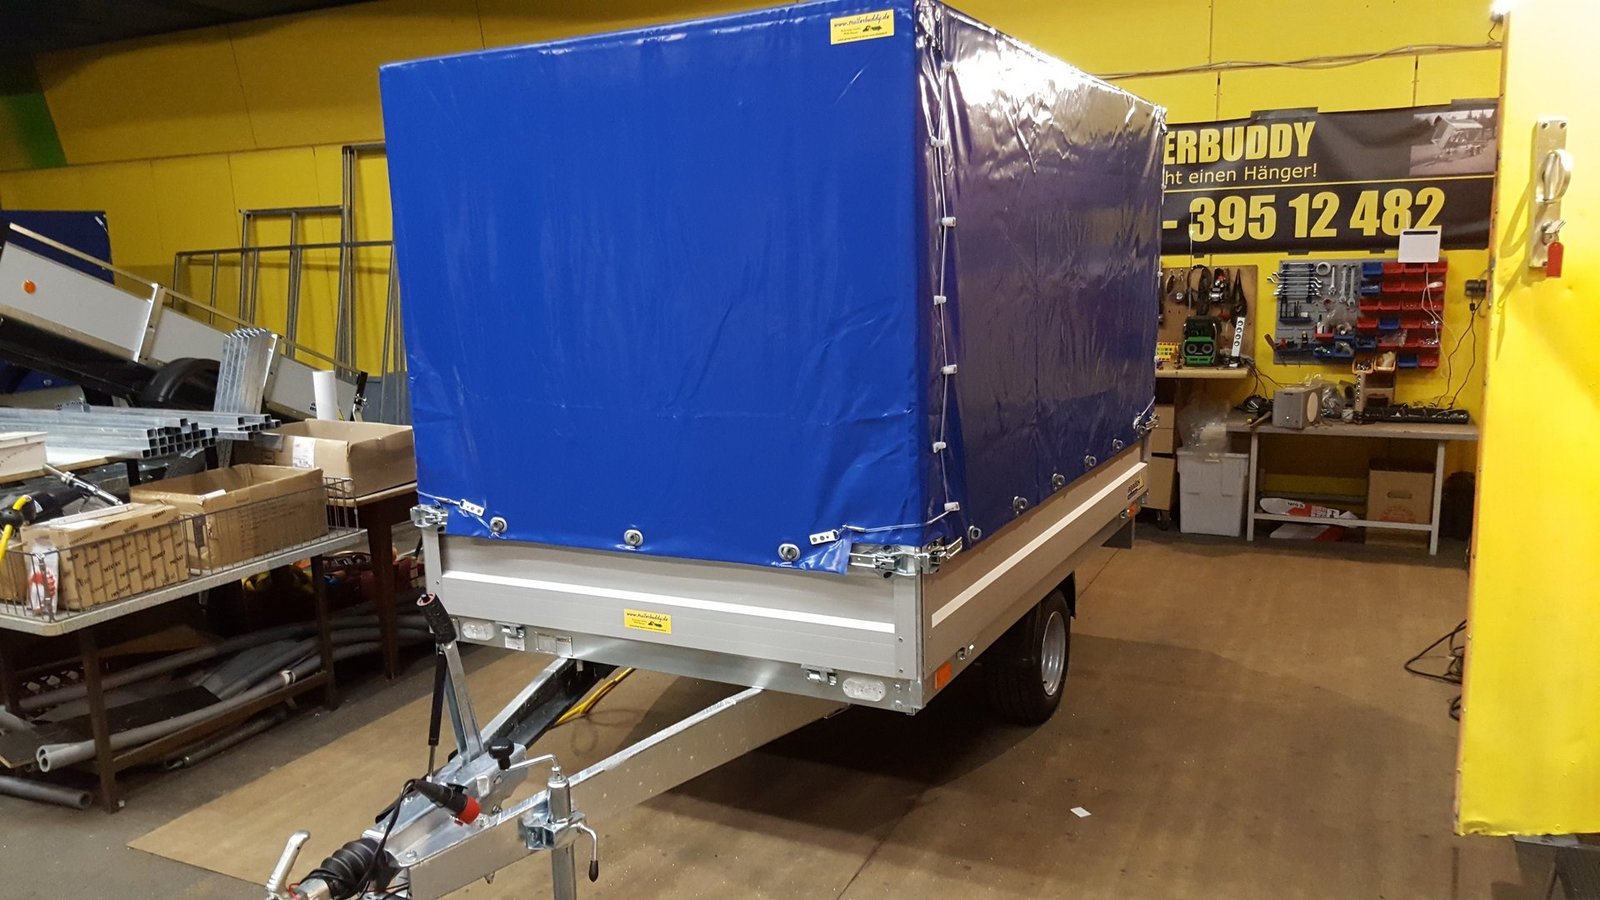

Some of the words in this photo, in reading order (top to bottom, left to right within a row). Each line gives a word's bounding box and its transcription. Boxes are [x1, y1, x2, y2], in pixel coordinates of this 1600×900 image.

[1163, 121, 1316, 165] ERBUDDY
[1188, 168, 1237, 184] einen
[1244, 163, 1318, 185] Hänger!
[1188, 194, 1277, 243] 395
[1288, 191, 1340, 239] 12
[1349, 187, 1446, 237] 482
